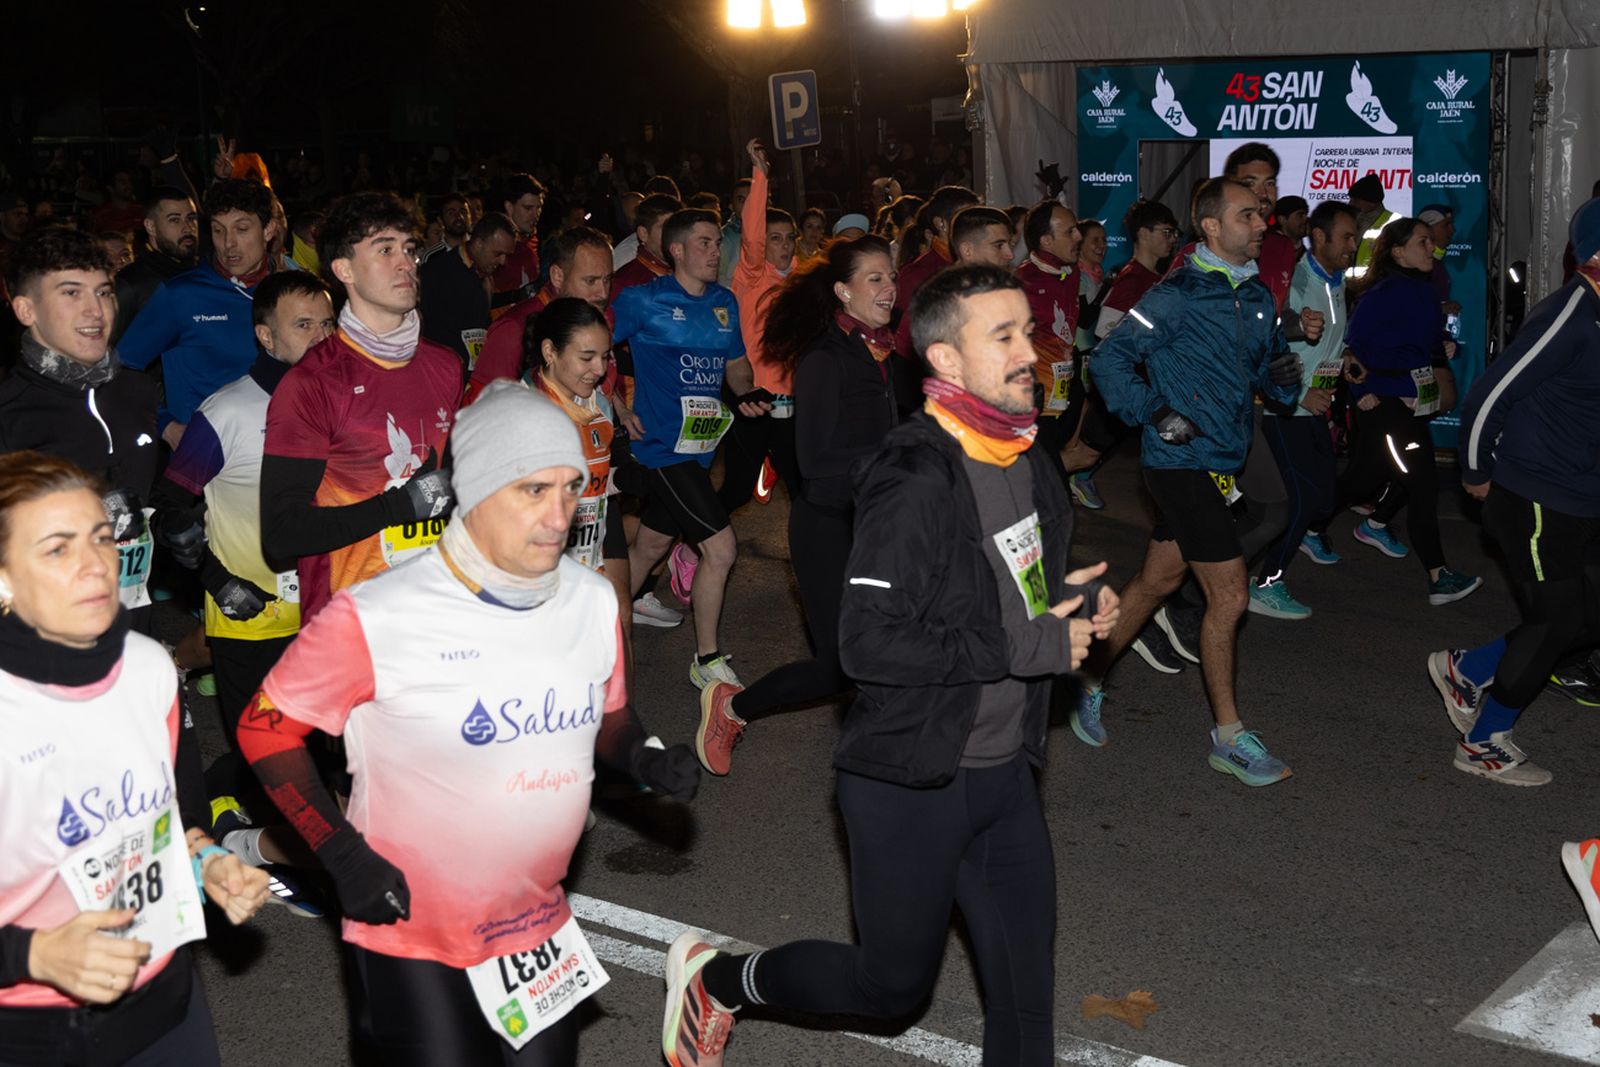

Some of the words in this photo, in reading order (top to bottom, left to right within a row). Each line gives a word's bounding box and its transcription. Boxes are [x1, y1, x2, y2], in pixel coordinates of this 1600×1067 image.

[1225, 73, 1261, 102] 43
[1262, 71, 1324, 99] SAN
[781, 82, 809, 139] P
[1216, 95, 1318, 131] ANTÓN
[1361, 101, 1380, 122] 43
[1426, 101, 1446, 109] CAJA
[1447, 101, 1476, 109] RURAL
[1165, 106, 1182, 126] 43
[1315, 148, 1348, 156] CARRERA
[1349, 148, 1379, 156] URBANA
[1313, 159, 1345, 168] NOCHE
[1347, 159, 1360, 168] DE
[1081, 172, 1133, 182] calderón
[1309, 169, 1357, 190] SAN
[1417, 172, 1481, 183] calderón
[680, 353, 710, 370] ORO
[691, 417, 722, 435] 6019
[496, 682, 597, 743] Salud
[80, 761, 174, 837] Salud
[130, 835, 145, 851] DE
[497, 937, 562, 994] 1837
[561, 952, 580, 977] SAN
[549, 977, 576, 1005] NOCHE
[535, 997, 550, 1015] DE
